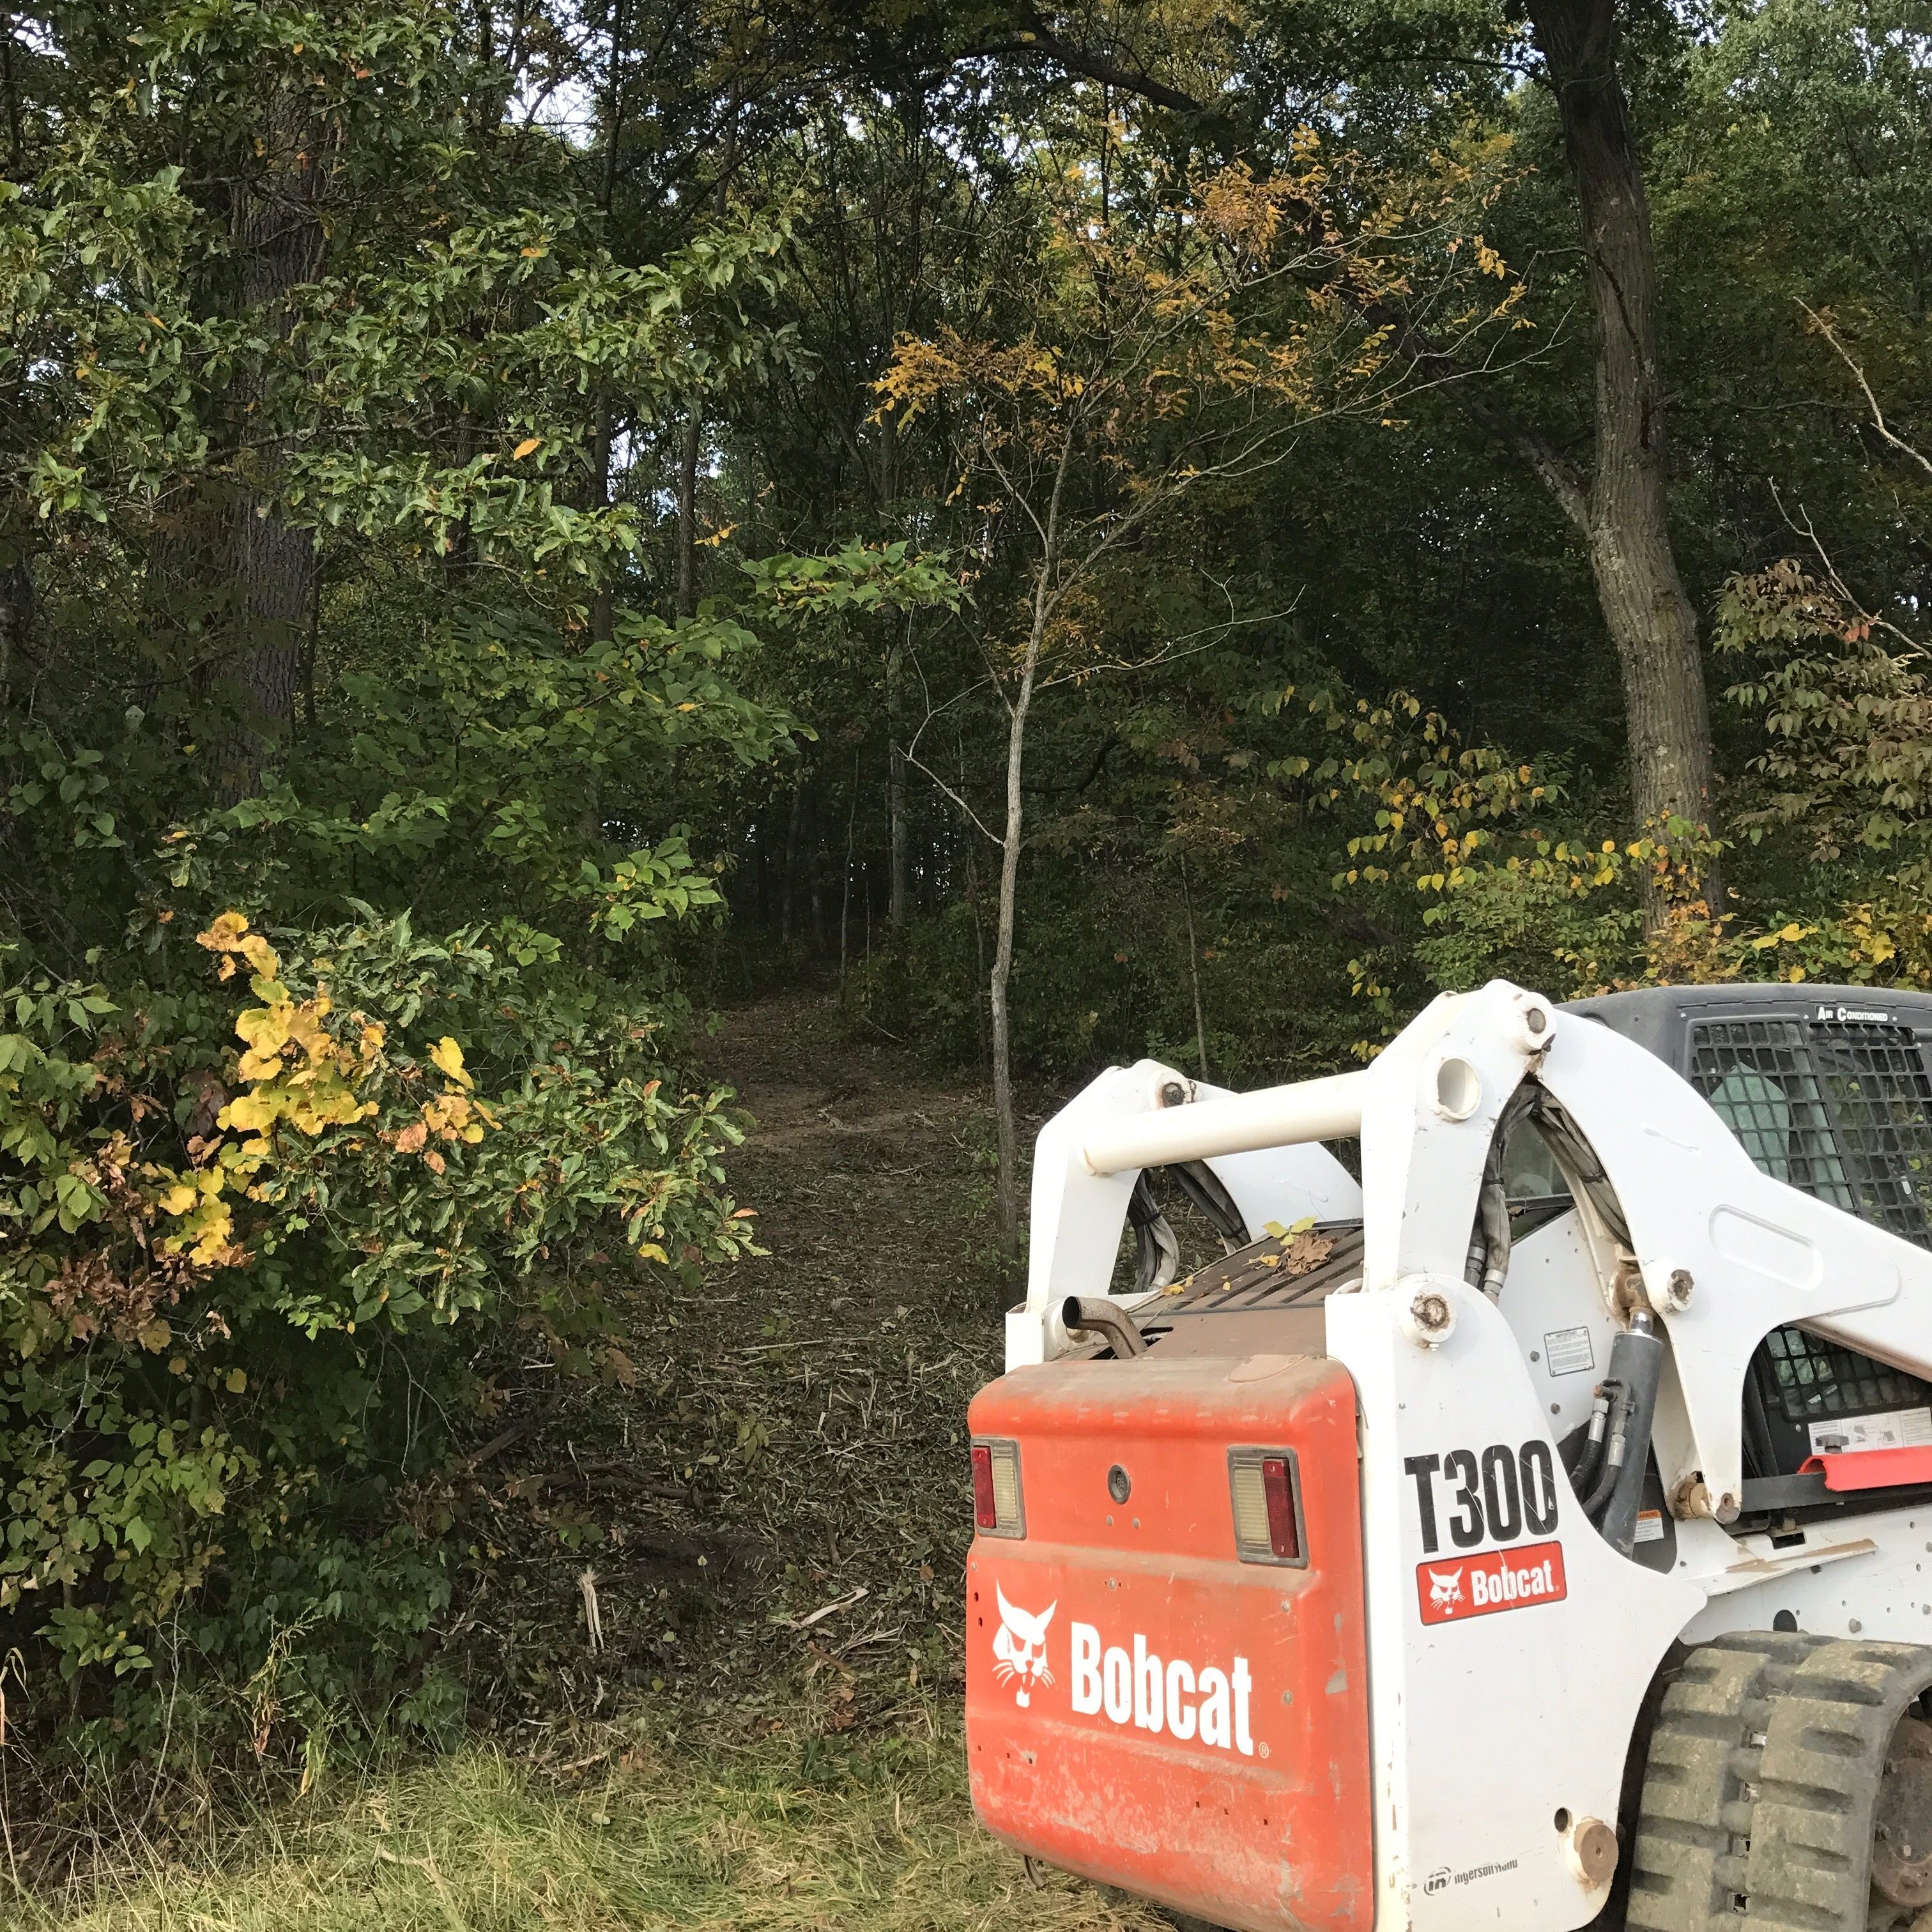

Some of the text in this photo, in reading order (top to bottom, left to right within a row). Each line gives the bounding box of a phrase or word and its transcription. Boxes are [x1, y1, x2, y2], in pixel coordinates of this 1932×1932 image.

[1404, 1440, 1559, 1554] T300
[1471, 1560, 1554, 1606] Bobcat
[1071, 1621, 1254, 1756] Bobcat
